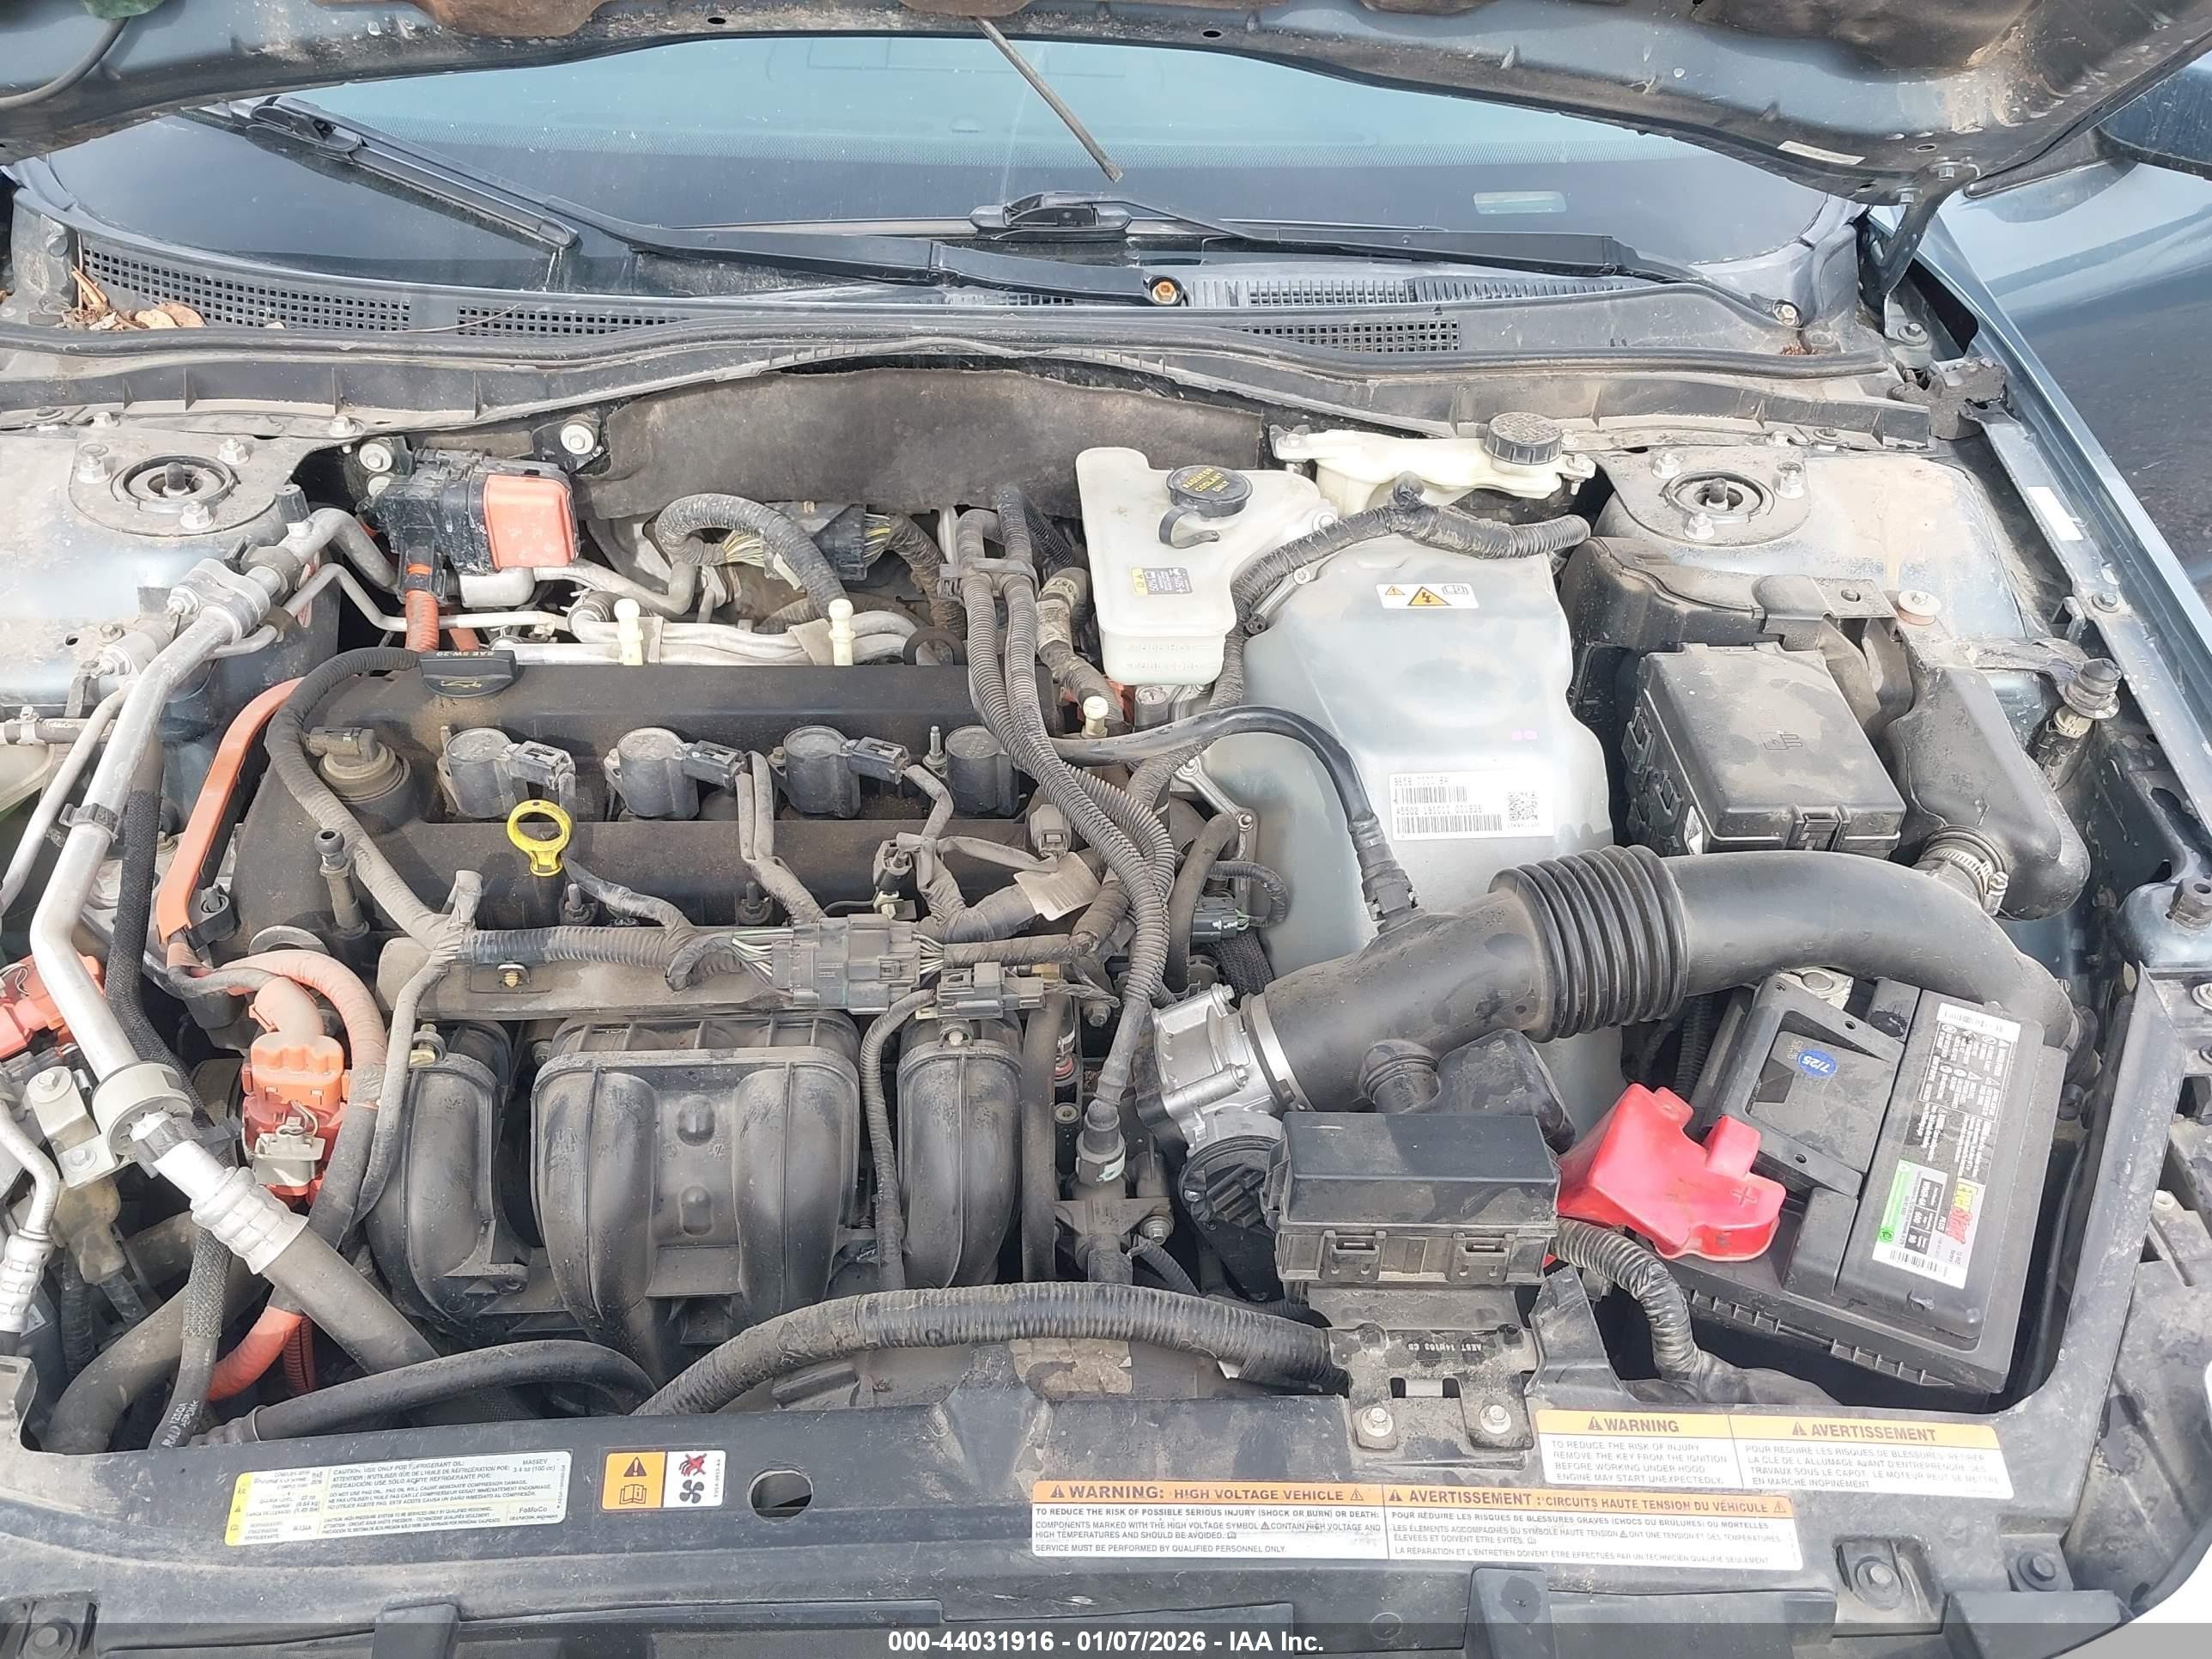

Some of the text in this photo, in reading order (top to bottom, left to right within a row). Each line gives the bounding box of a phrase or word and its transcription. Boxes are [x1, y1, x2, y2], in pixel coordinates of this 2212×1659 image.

[1182, 468, 1215, 489] RADIATOR
[1195, 472, 1224, 492] COOLANT
[1212, 480, 1230, 492] ONLY
[1802, 1055, 1831, 1073] 7/25
[1936, 1216, 1947, 1231] PLUS
[1604, 1418, 1679, 1432] WARNING
[1811, 1424, 1936, 1441] AVERTISSEMENT
[1566, 1441, 1605, 1449] REDUCE
[1553, 1451, 1592, 1460] REMOVE
[1686, 1455, 1727, 1463] IGNITION
[1836, 1448, 1874, 1457] RISQUES
[1891, 1449, 1943, 1459] BLESSURES
[1595, 1463, 1640, 1472] WORKING
[1750, 1467, 1792, 1476] TRAVAUX
[1794, 1468, 1819, 1476] SOUS
[1767, 1478, 1807, 1486] MARCHE
[1069, 1486, 1344, 1501] WARNING: HIGH VOLTAGE VEHICLE
[1409, 1490, 1532, 1505] AVERTISSEMENT
[1547, 1497, 1597, 1507] CIRCUITS
[1601, 1498, 1638, 1509] HAUTE
[1643, 1499, 1690, 1510] TENSION
[1695, 1501, 1709, 1511] DU
[1527, 1515, 1574, 1523] BLESSURES
